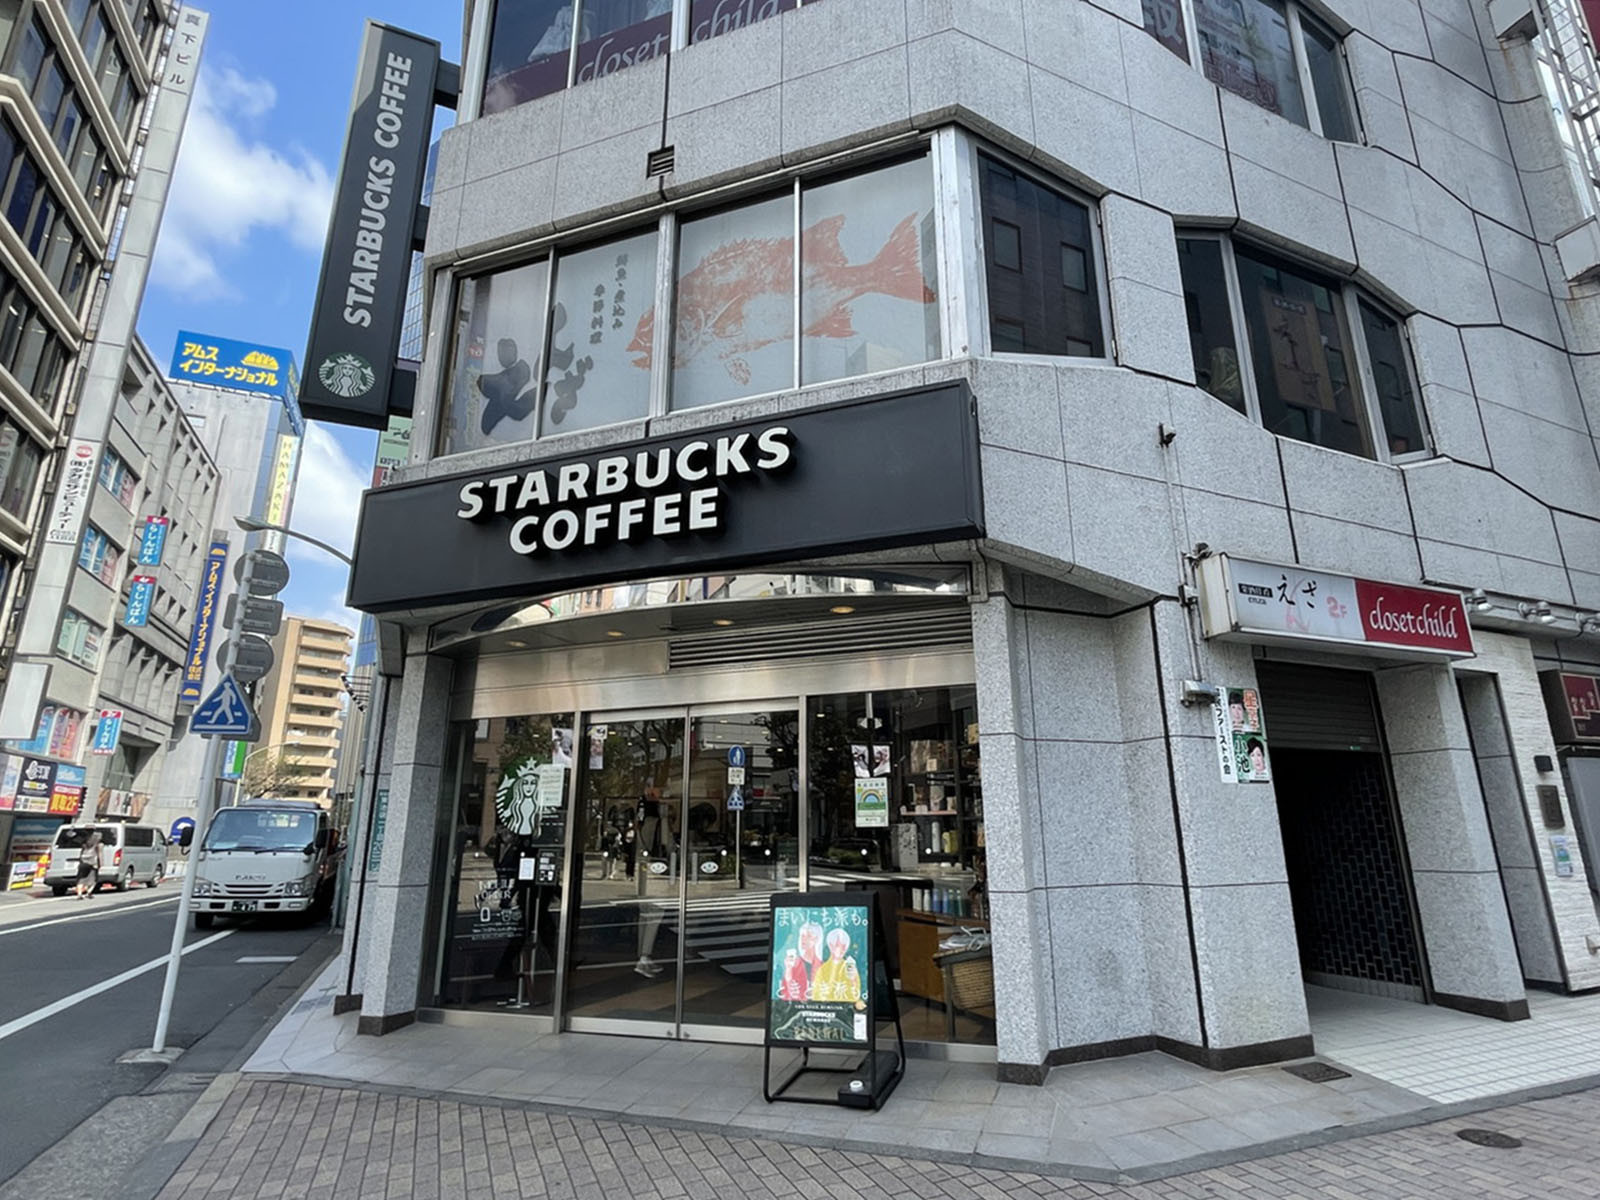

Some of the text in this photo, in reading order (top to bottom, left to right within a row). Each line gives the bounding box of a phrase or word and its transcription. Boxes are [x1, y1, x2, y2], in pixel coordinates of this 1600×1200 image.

[577, 0, 781, 83] closet child
[344, 52, 413, 328] STARBUCKS COFFEE
[180, 359, 278, 387] インターナショナル
[182, 342, 219, 361] アムス
[457, 427, 791, 519] STARBUCKS
[509, 487, 719, 554] COFFEE
[141, 524, 159, 565] らしんばん
[128, 583, 145, 625] らしんばん
[1370, 596, 1458, 639] closet child
